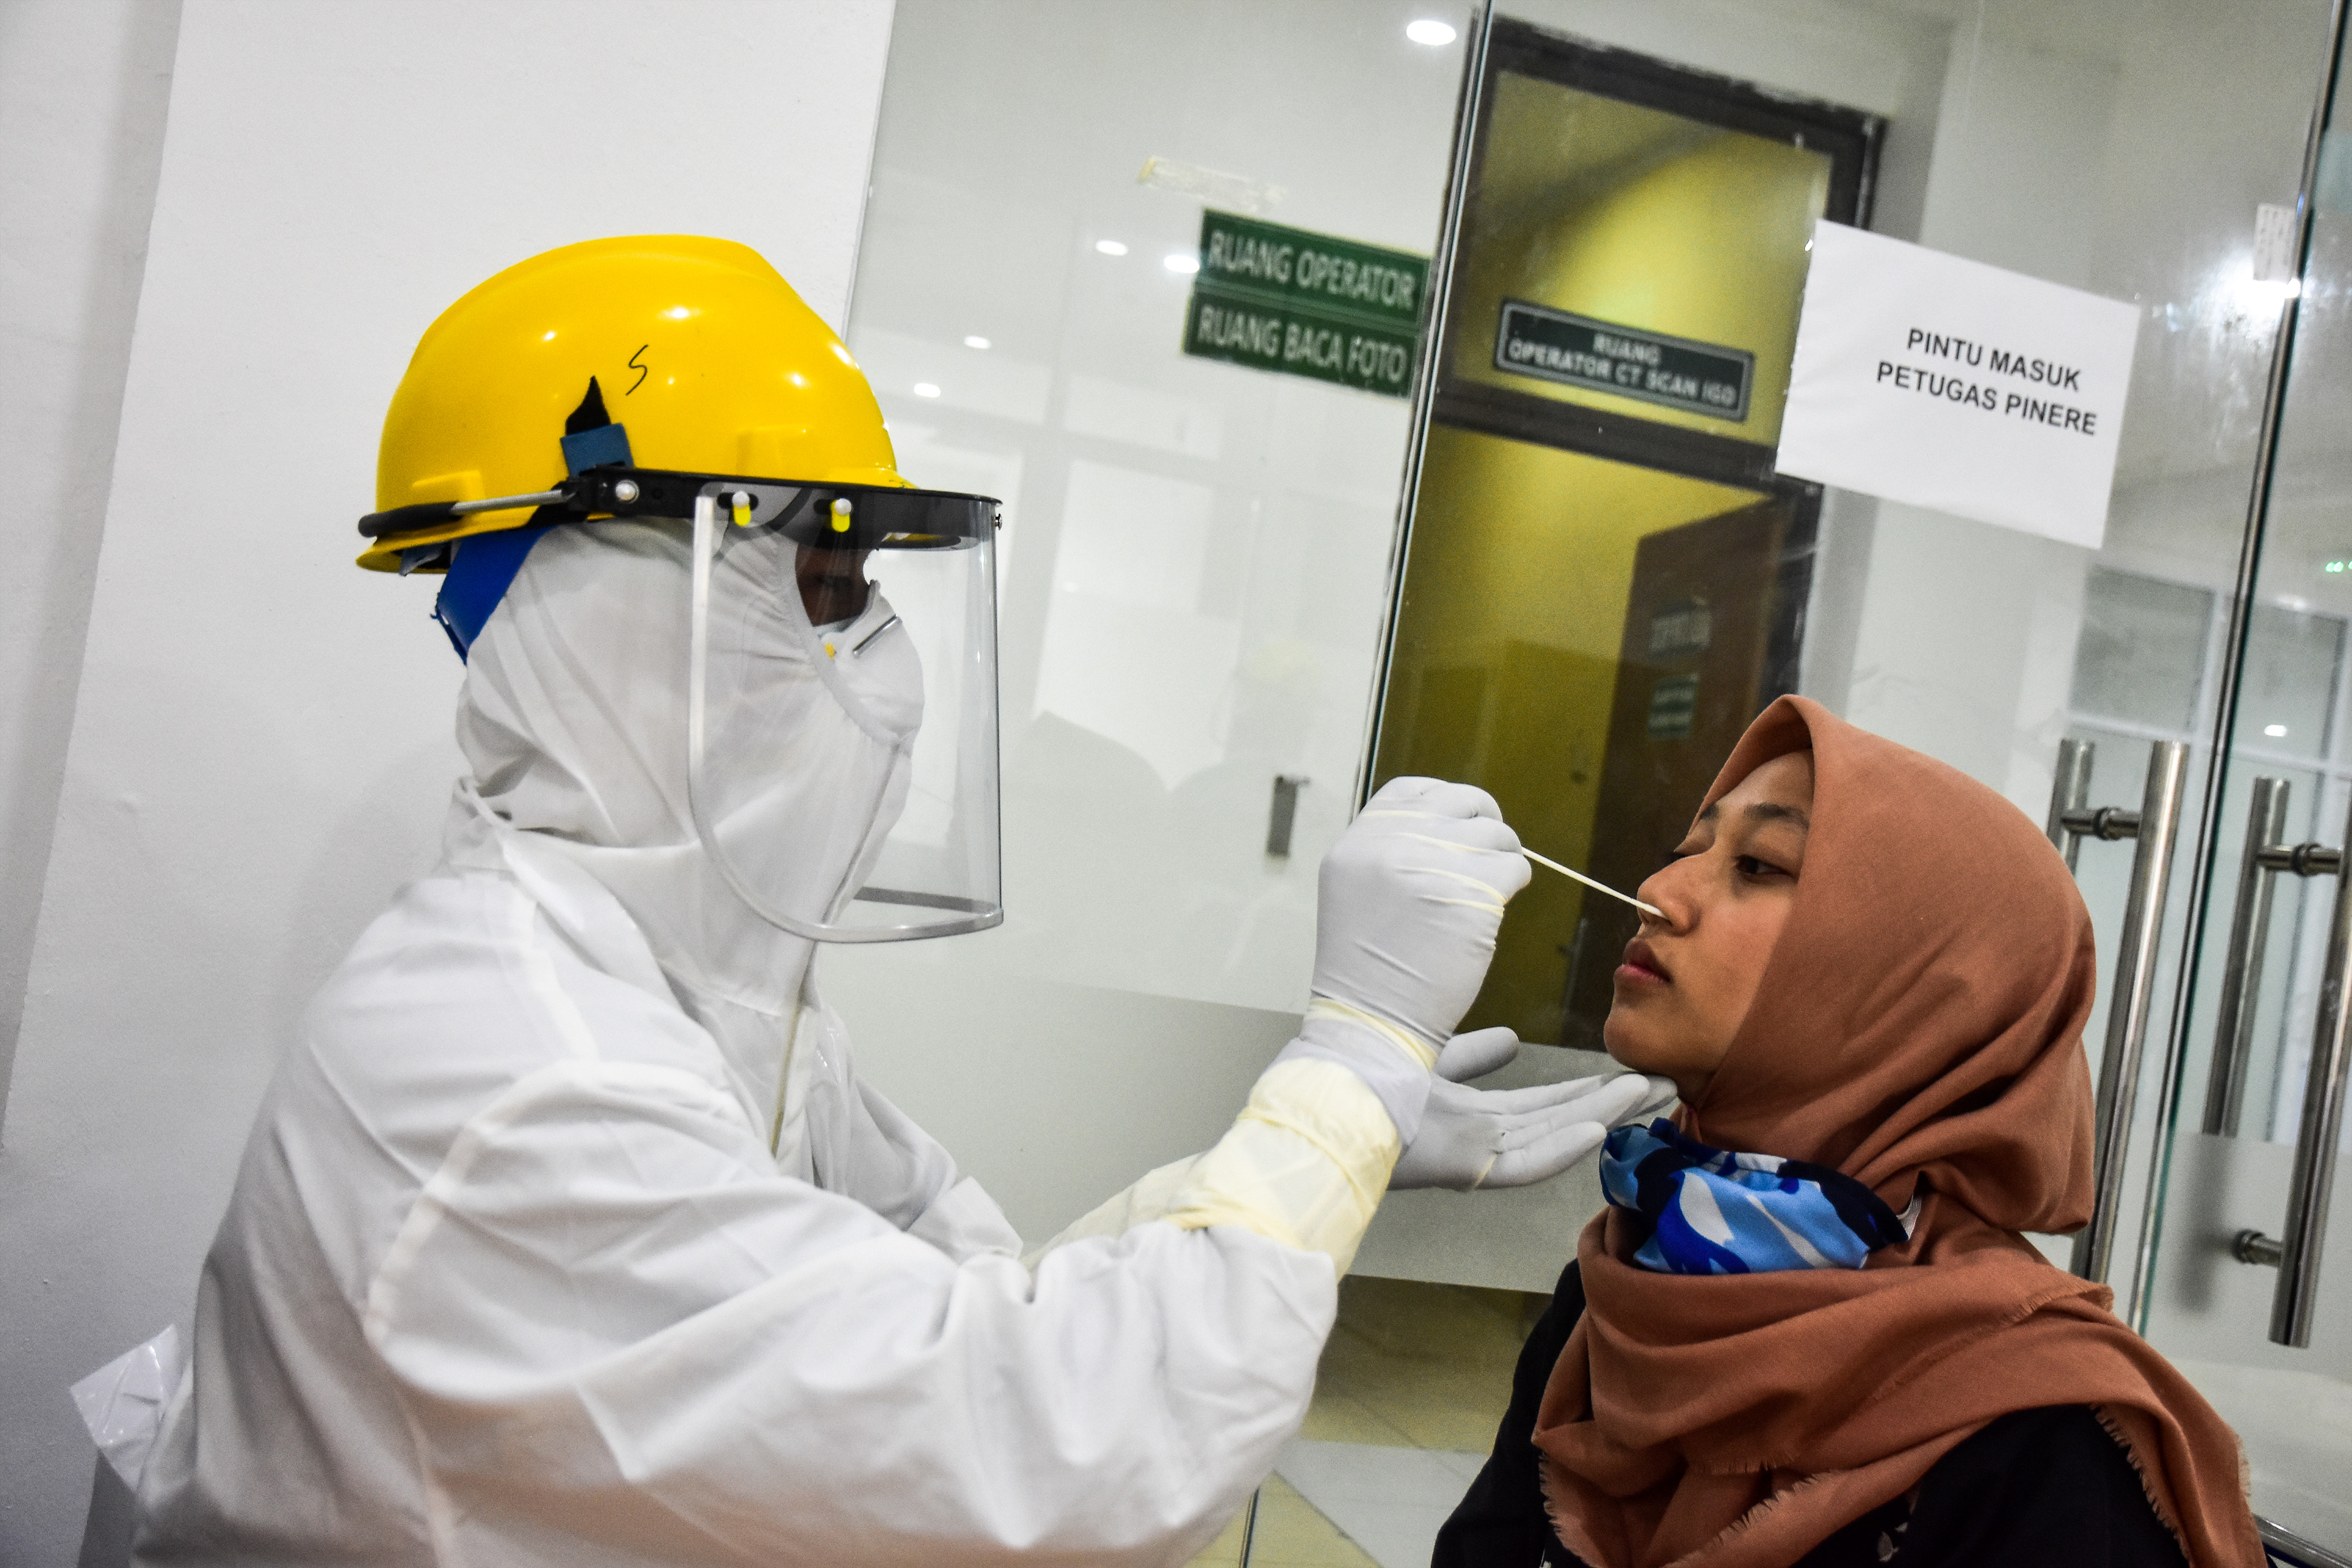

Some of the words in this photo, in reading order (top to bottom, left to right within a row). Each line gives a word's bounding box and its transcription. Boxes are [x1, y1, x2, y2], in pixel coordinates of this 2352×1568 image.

[1209, 229, 1294, 283] RUANG
[1297, 250, 1415, 309] OPERATOR
[1198, 306, 1280, 357] RUANG
[1284, 325, 1342, 370] BACA
[1348, 337, 1406, 382] FOTO
[1508, 339, 1612, 379] OPERATOR
[1615, 364, 1642, 386] CT
[1645, 370, 1698, 397] SCAN
[1593, 333, 1661, 366] RUANG
[1907, 328, 1983, 366] PINTU
[1990, 349, 2081, 392] MASUK
[1877, 362, 1997, 410] PETUGAS
[2005, 394, 2097, 435] PINERE
